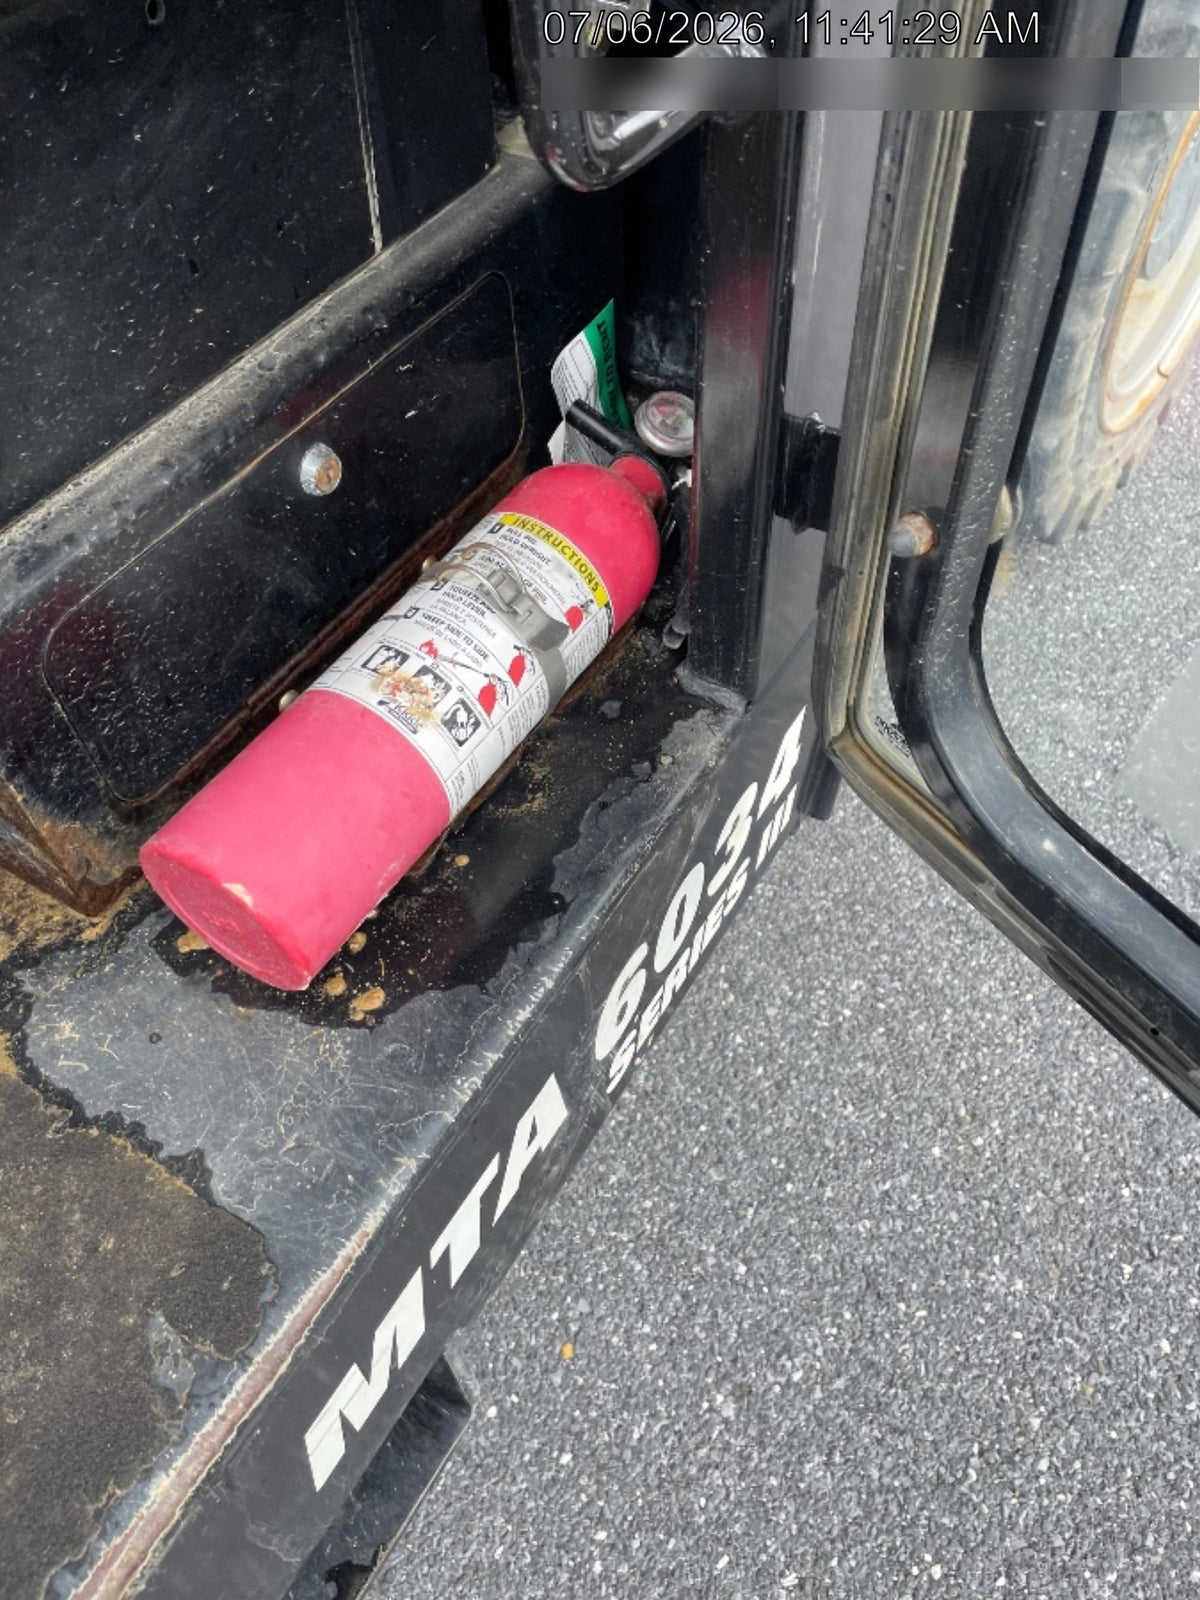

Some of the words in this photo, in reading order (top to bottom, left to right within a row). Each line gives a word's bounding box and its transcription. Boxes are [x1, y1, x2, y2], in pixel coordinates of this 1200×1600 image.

[446, 623, 462, 638] SIDE
[463, 635, 474, 647] TO
[512, 516, 600, 592] INSTRUCTIONS
[606, 857, 751, 1094] SERIES
[755, 783, 798, 871] III
[304, 1072, 568, 1492] MTA
[594, 704, 807, 1061] 6034
